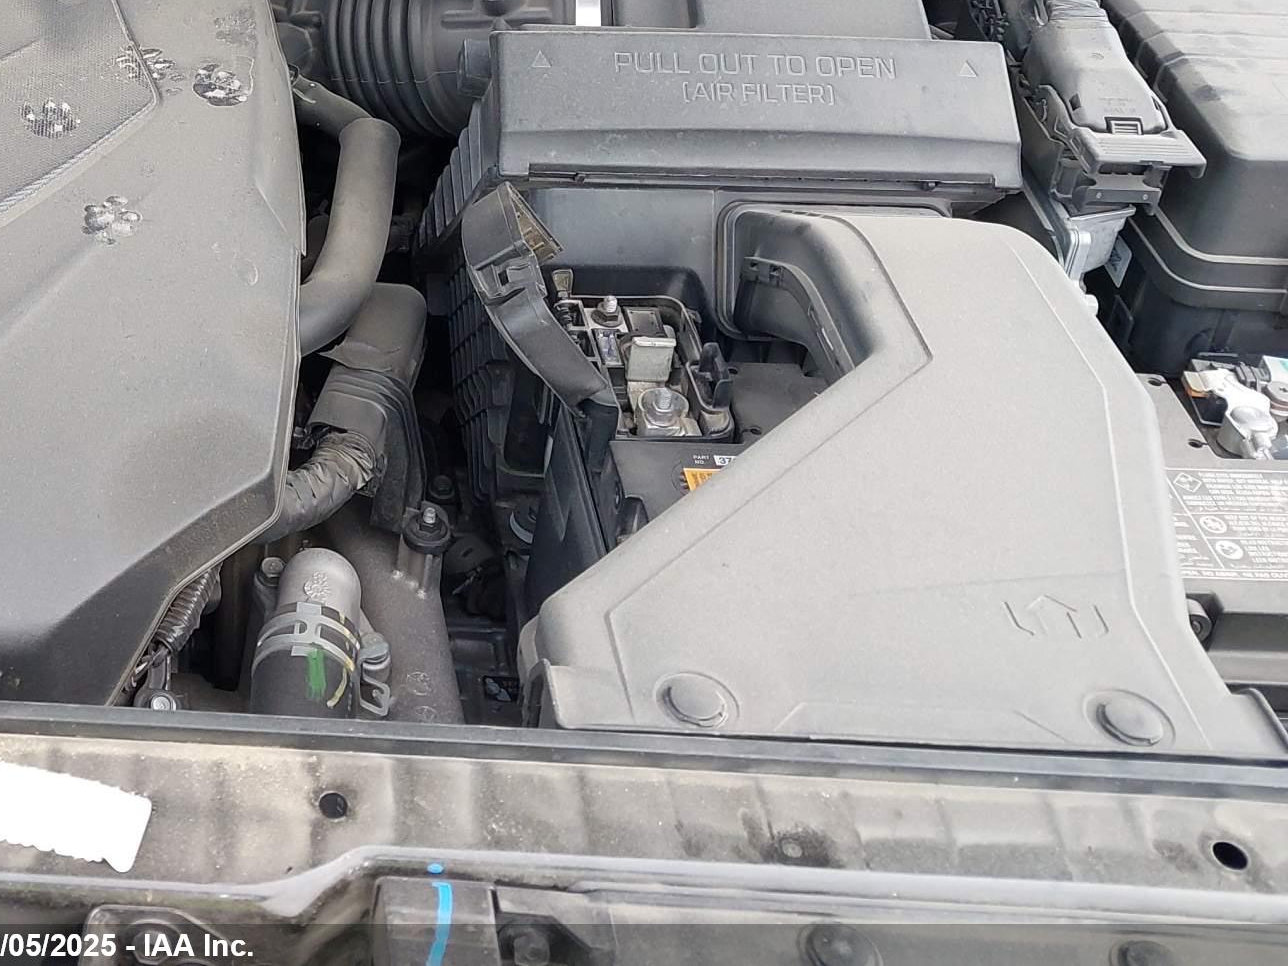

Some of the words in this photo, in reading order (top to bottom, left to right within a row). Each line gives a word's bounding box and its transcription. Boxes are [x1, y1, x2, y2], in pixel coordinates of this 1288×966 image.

[614, 52, 690, 74] PULL
[698, 53, 758, 75] OUT
[767, 54, 808, 76] TO
[815, 56, 897, 80] OPEN
